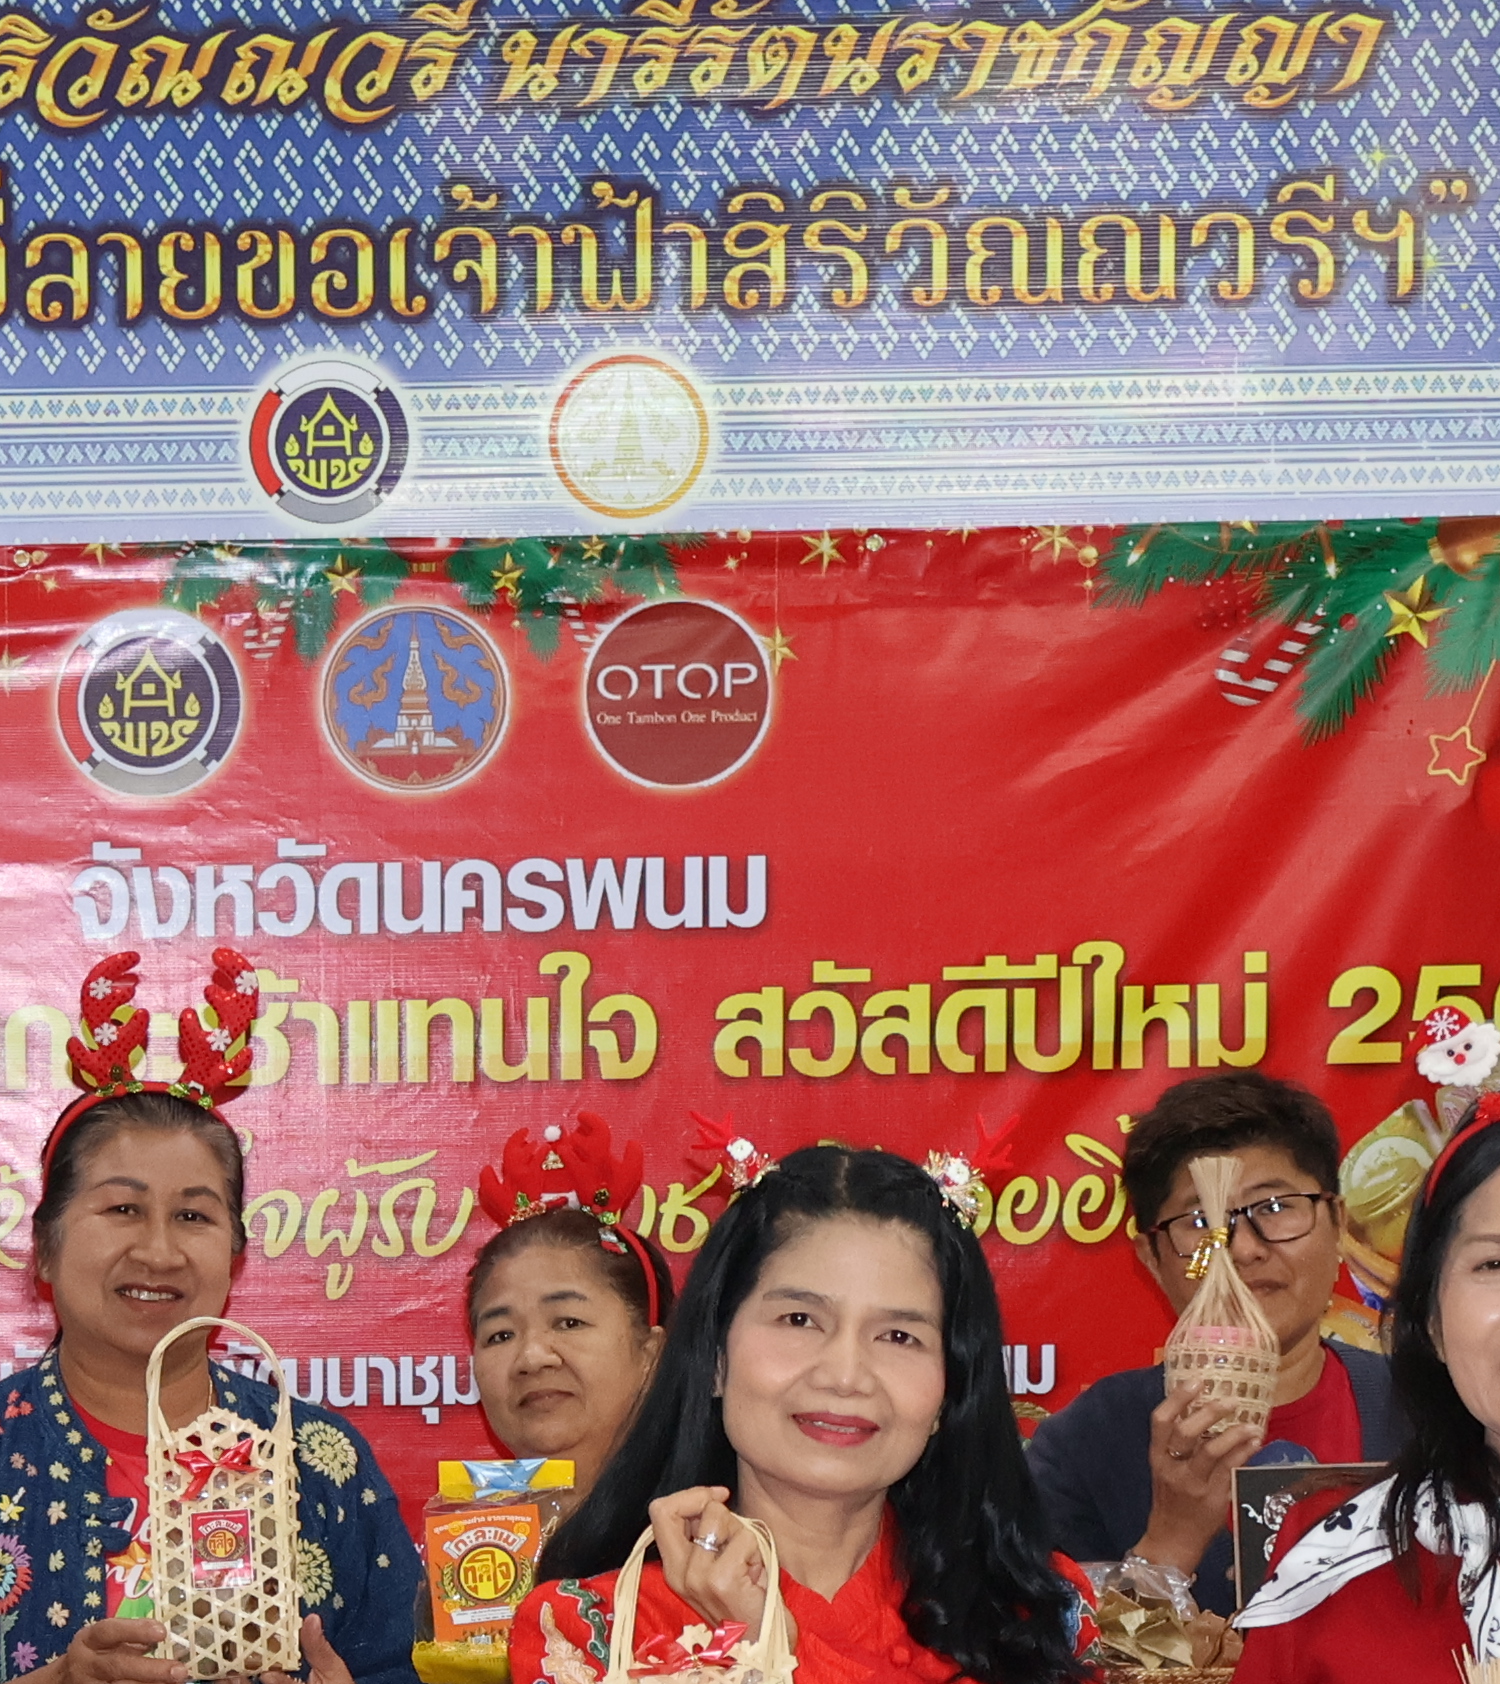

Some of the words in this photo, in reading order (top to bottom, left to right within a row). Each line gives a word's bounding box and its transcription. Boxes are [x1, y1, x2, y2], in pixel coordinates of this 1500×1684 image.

[596, 661, 759, 701] OTOP
[596, 711, 622, 725] One
[626, 711, 678, 724] Tambon
[680, 710, 707, 723] One
[710, 708, 758, 722] Product
[70, 836, 768, 942] จังหวัดนครพนม
[713, 939, 1269, 1081] สวัสดีปีใหม่
